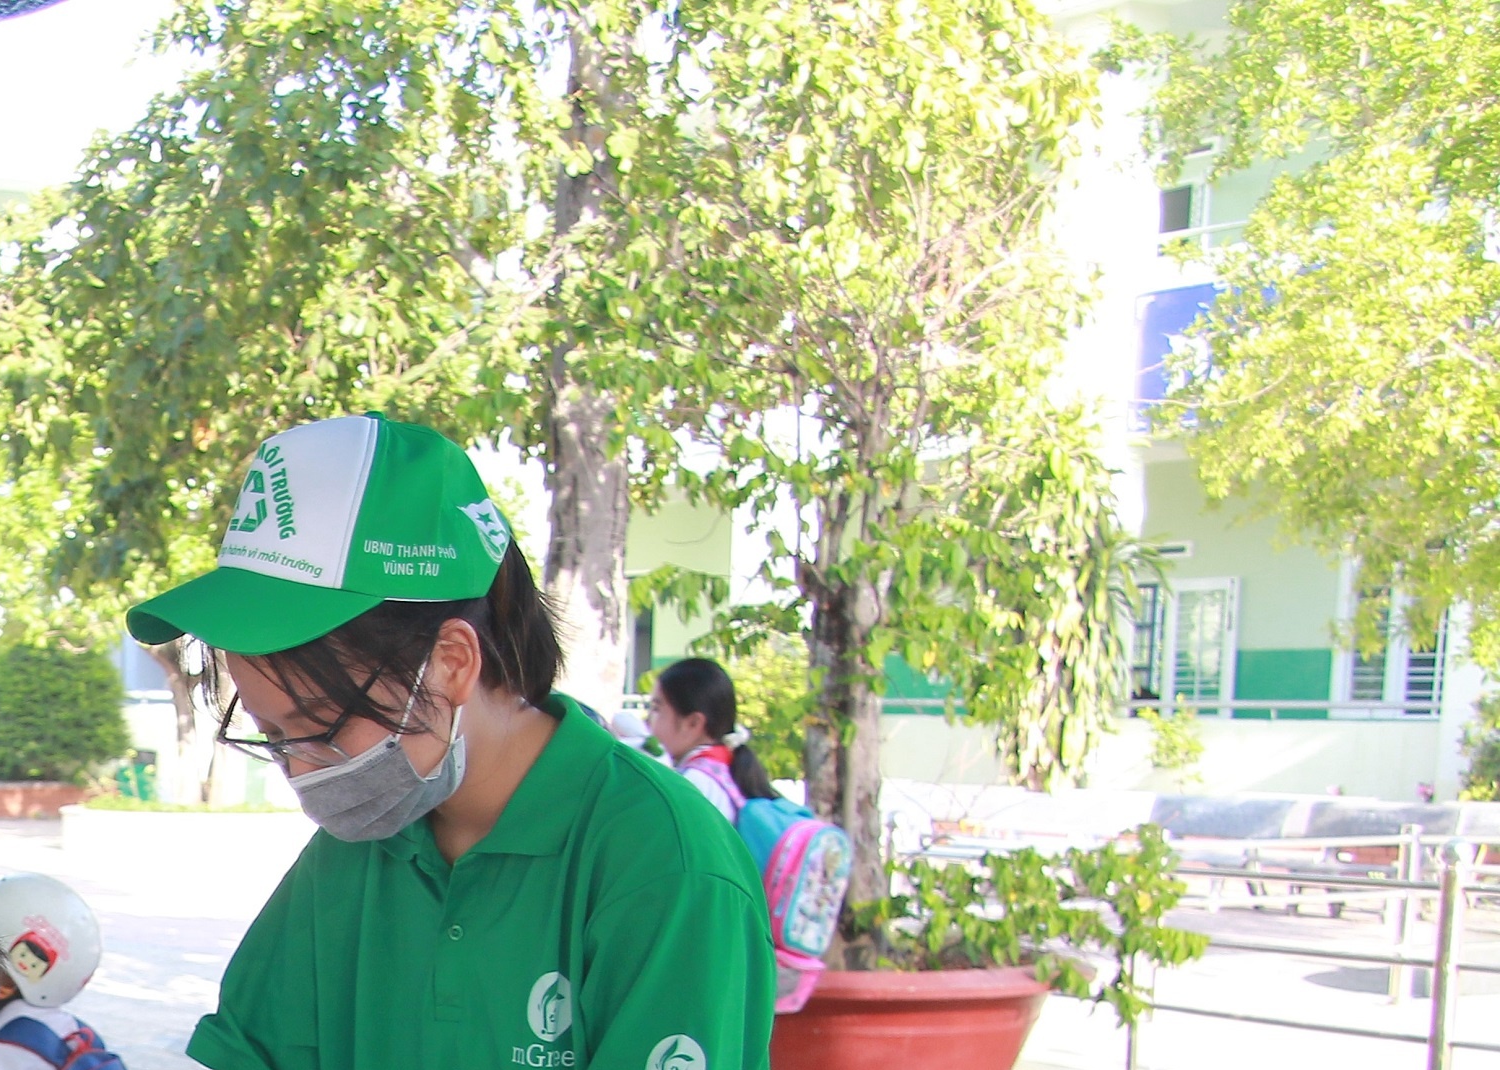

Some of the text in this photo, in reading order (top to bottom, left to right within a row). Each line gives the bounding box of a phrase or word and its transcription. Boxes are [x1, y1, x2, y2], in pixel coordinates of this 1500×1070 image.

[270, 468, 296, 540] TRƯỜNG
[363, 539, 394, 556] UBND
[257, 550, 282, 564] môi
[281, 555, 323, 579] trường
